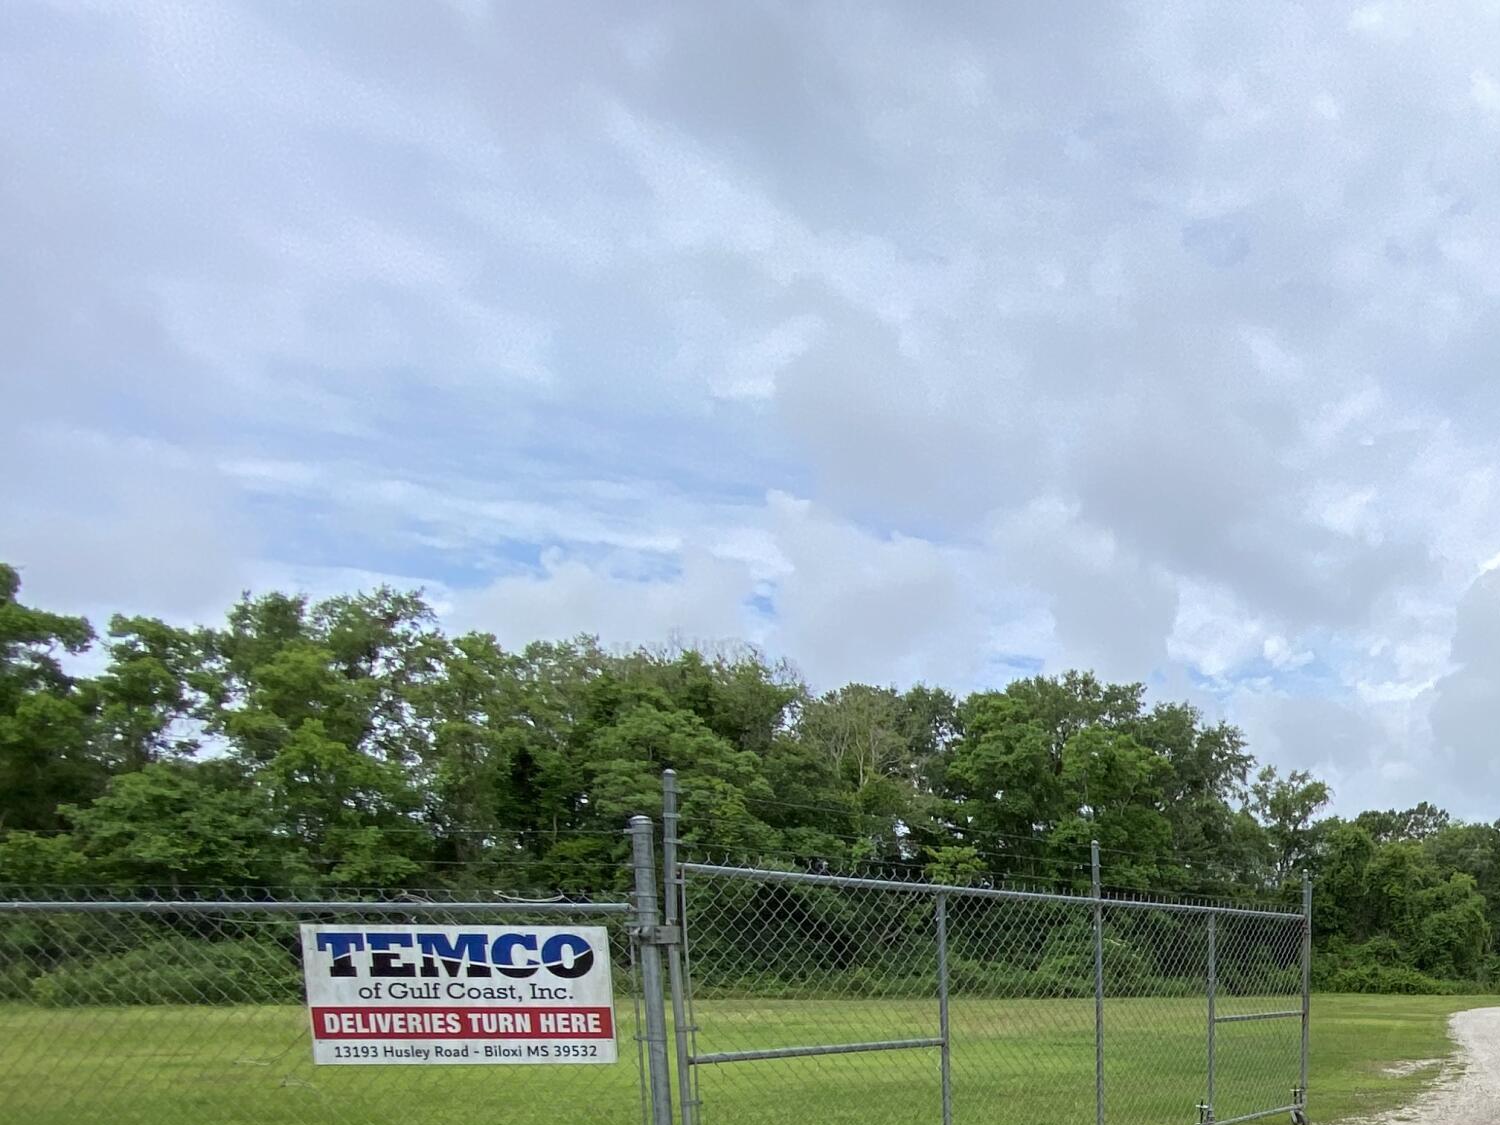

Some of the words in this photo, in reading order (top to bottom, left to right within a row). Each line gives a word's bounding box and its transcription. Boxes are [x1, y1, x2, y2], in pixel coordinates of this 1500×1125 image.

[316, 932, 595, 979] TEMCO
[358, 982, 382, 1000] of
[388, 982, 441, 1001] Gulf
[446, 982, 523, 1003] Coast,
[530, 983, 574, 1000] Inc.
[324, 1013, 462, 1034] DELIVERIES
[468, 1013, 530, 1034] TURN
[540, 1013, 602, 1034] HERE
[334, 1045, 378, 1058] 13193
[383, 1045, 431, 1061] Husley
[434, 1045, 469, 1058] Road
[484, 1045, 523, 1058] Biloxi
[527, 1045, 549, 1058] MS
[554, 1045, 598, 1058] 39532
